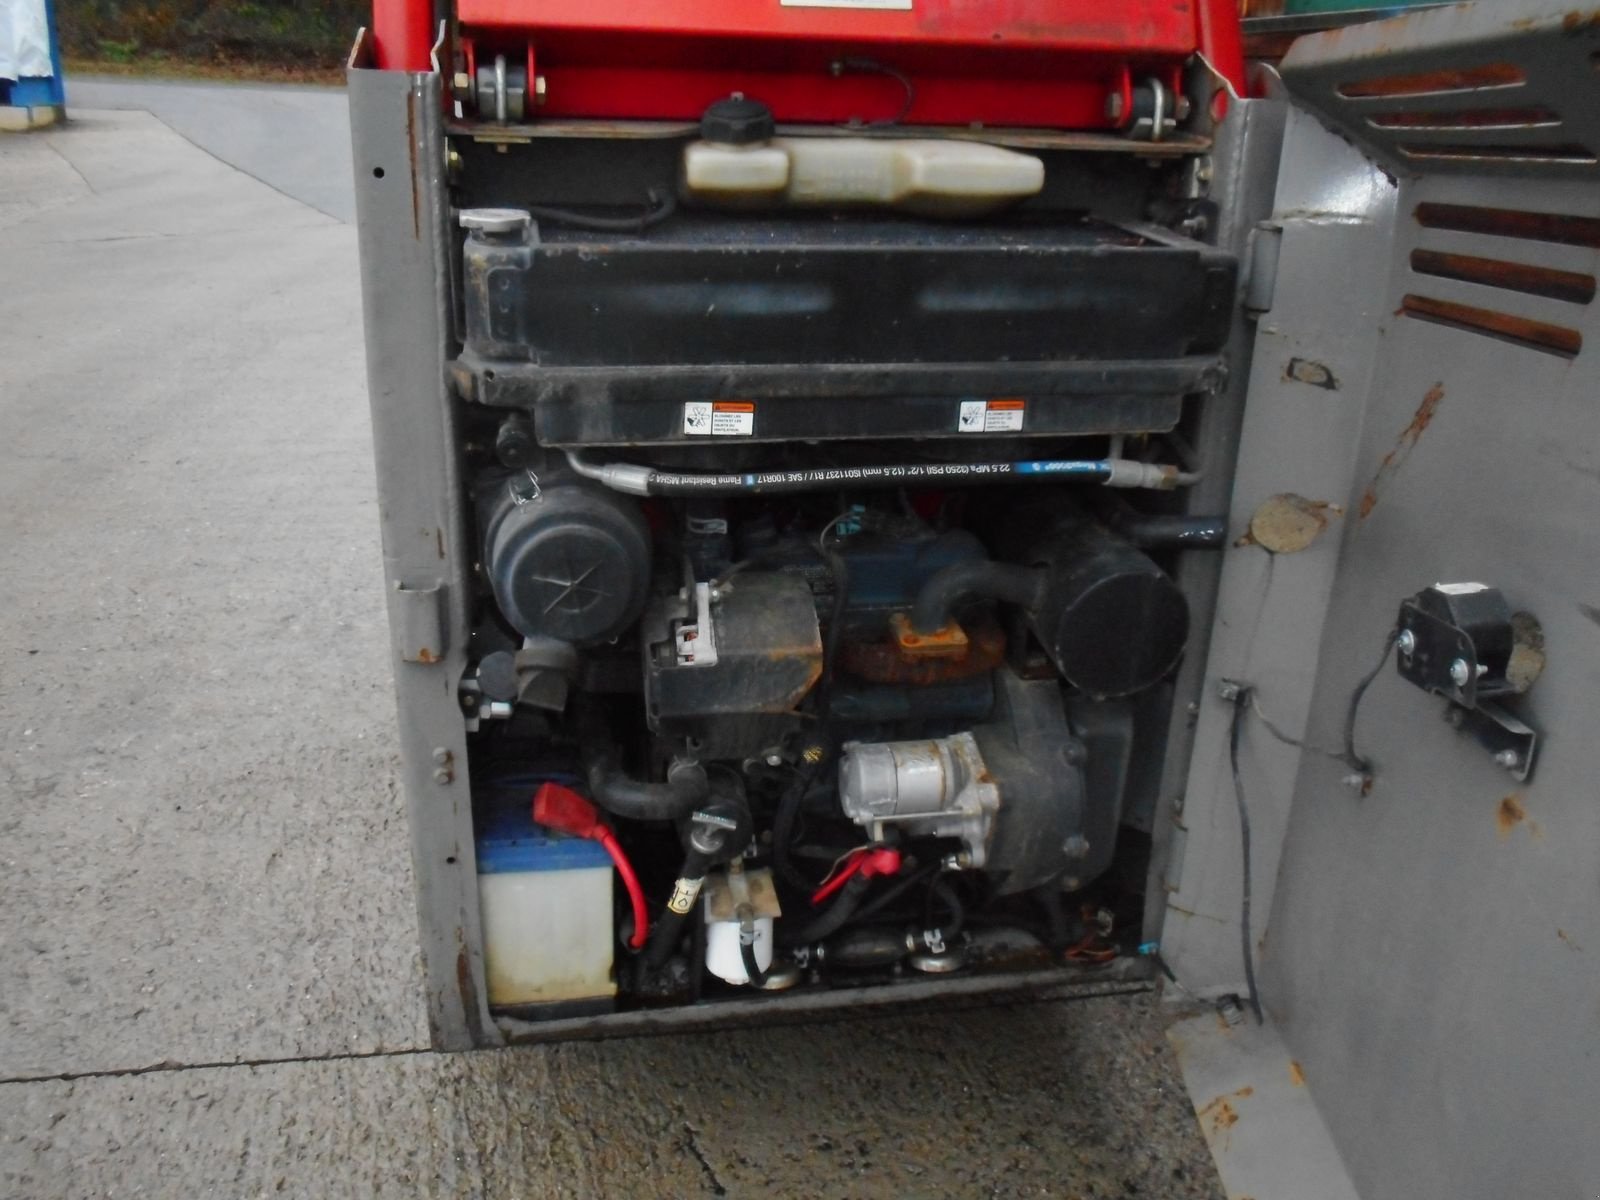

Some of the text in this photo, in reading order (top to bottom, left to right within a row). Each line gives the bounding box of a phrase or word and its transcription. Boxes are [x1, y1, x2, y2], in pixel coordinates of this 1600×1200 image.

[861, 467, 882, 478] mm)
[883, 466, 905, 476] (12.5
[926, 466, 944, 475] PSI)
[945, 465, 969, 474] (3250
[969, 464, 990, 473] MPa
[991, 463, 1010, 473] 22.5
[656, 474, 680, 485] MSHA
[757, 473, 785, 484] 100R17
[787, 472, 803, 482] SAE
[825, 469, 861, 480] ISO11237
[681, 475, 717, 486] Resistant
[718, 475, 742, 485] Flame
